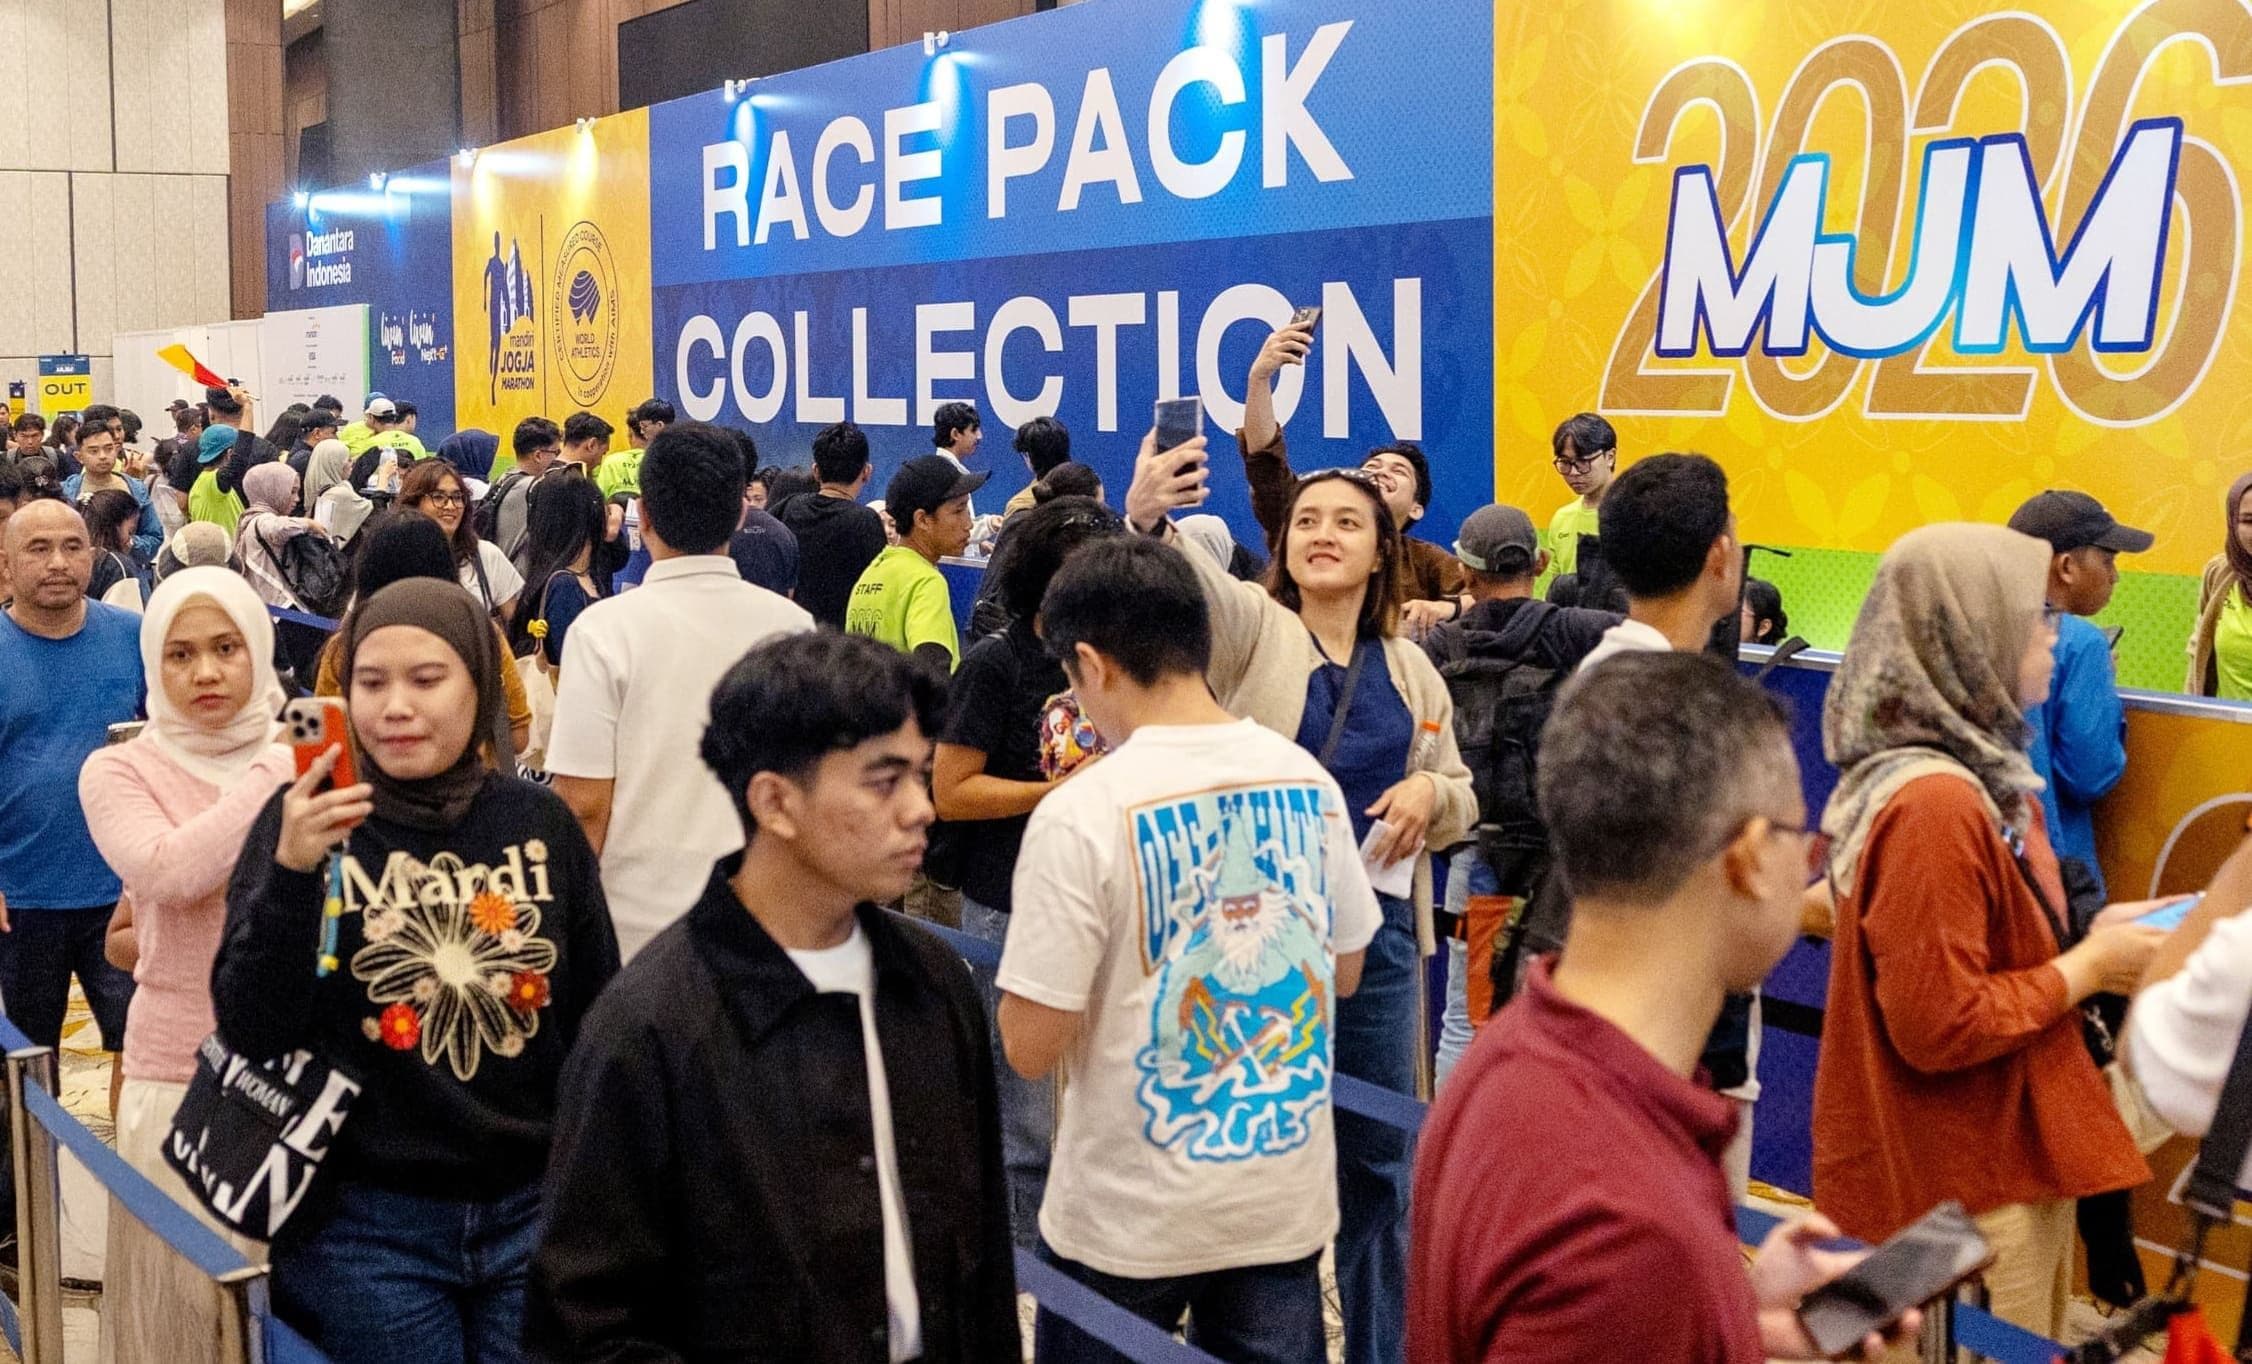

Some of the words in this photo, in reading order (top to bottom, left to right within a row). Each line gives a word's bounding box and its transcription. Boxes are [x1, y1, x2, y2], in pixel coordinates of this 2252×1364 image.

[703, 101, 942, 250] RACE
[987, 19, 1355, 219] PACK
[1598, 0, 2252, 428] 2026
[306, 227, 354, 257] Danantara
[1654, 116, 2184, 358] MUM
[306, 255, 352, 288] Indonesia
[571, 346, 601, 359] ATHLETICS
[575, 332, 595, 344] WORLD
[501, 350, 535, 373] JOGJA
[676, 276, 1422, 442] COLLECTION
[45, 383, 86, 395] OUT
[501, 377, 535, 390] MARATHON
[855, 583, 884, 596] STAFF
[340, 838, 555, 912] Mardi
